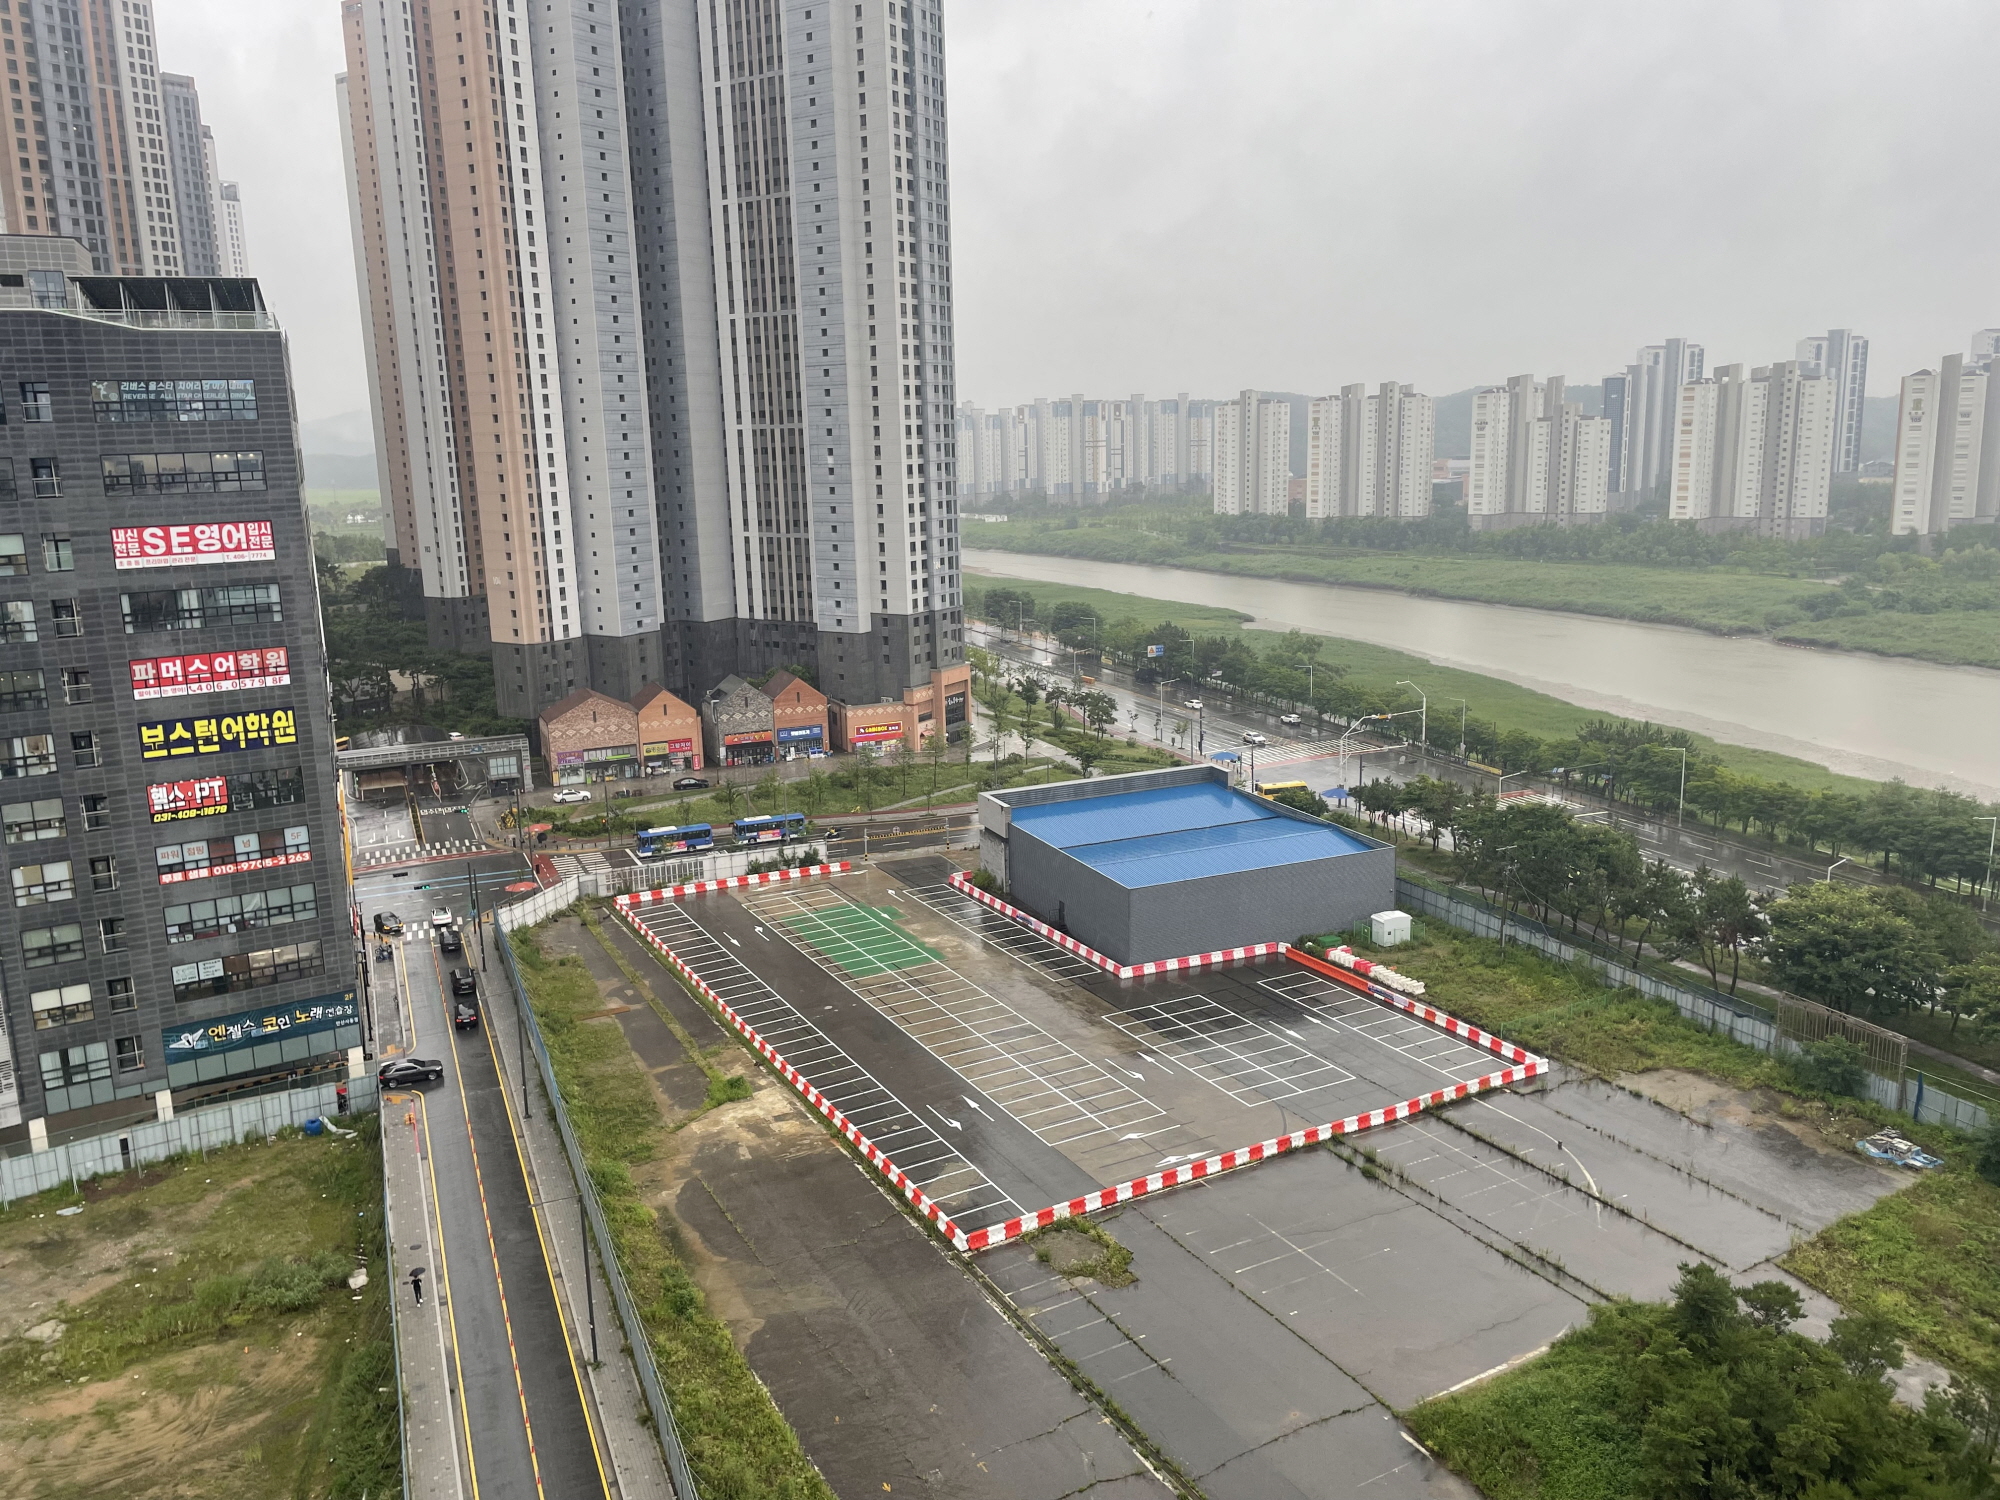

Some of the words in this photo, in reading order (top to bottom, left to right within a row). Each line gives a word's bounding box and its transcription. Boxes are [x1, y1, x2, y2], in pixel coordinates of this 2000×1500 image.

[121, 381, 147, 391] 리버스
[148, 381, 174, 391] 올스타
[112, 528, 139, 542] 내신
[247, 522, 272, 535] 입시
[142, 523, 248, 556] SE영어
[249, 535, 273, 549] 전문
[114, 542, 141, 557] 전문
[132, 650, 287, 685] 파머스어학원
[271, 676, 284, 685] 8F
[140, 709, 297, 759] 보스턴어학원
[160, 849, 179, 860] 파워
[290, 831, 302, 841] 5F
[161, 872, 183, 884] 무료
[344, 993, 354, 1001] 2F
[208, 1019, 257, 1042] 엔젤스
[262, 1014, 292, 1032] 코인
[295, 1006, 323, 1024] 노래
[325, 1004, 353, 1018] 연습장
